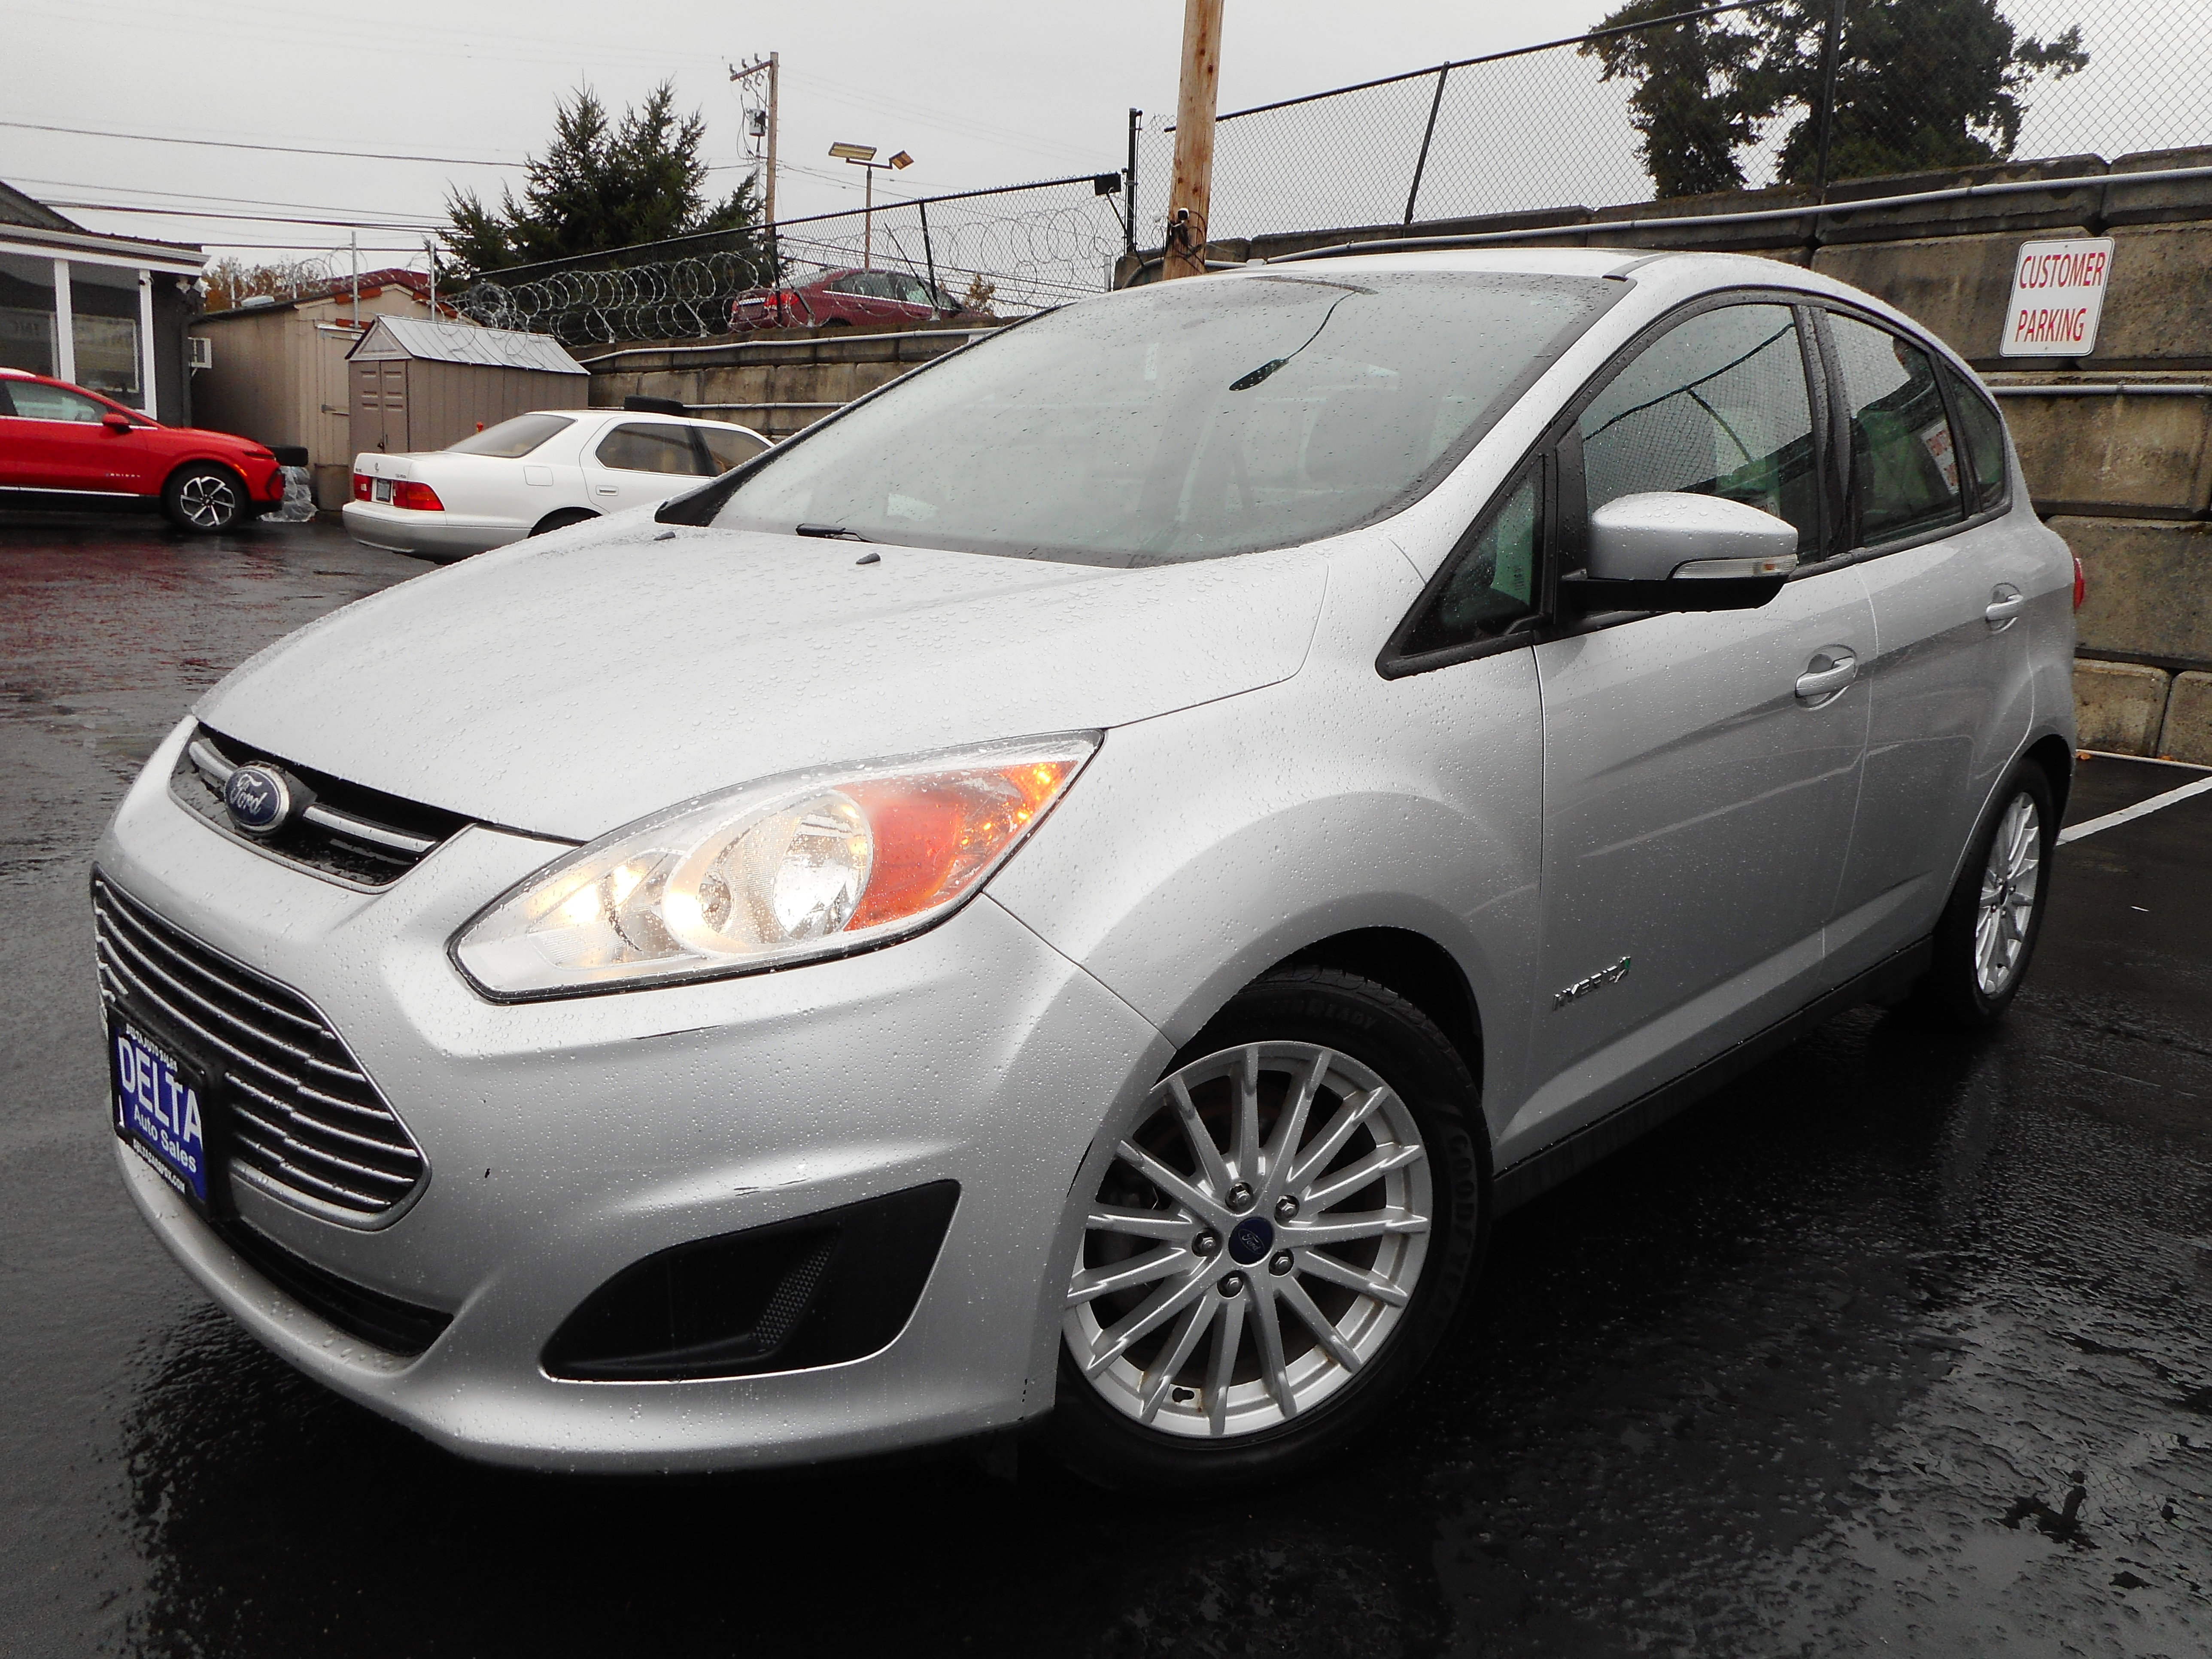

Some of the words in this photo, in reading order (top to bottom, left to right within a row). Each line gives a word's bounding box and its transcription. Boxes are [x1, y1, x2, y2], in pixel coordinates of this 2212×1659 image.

[2019, 252, 2106, 289] CUSTOMER
[2015, 308, 2087, 342] PARKING
[230, 774, 268, 814] Ford
[118, 1036, 203, 1152] DELTA
[134, 1104, 158, 1141] Auto
[161, 1128, 197, 1173] Sales
[1242, 1234, 1261, 1251] Ford
